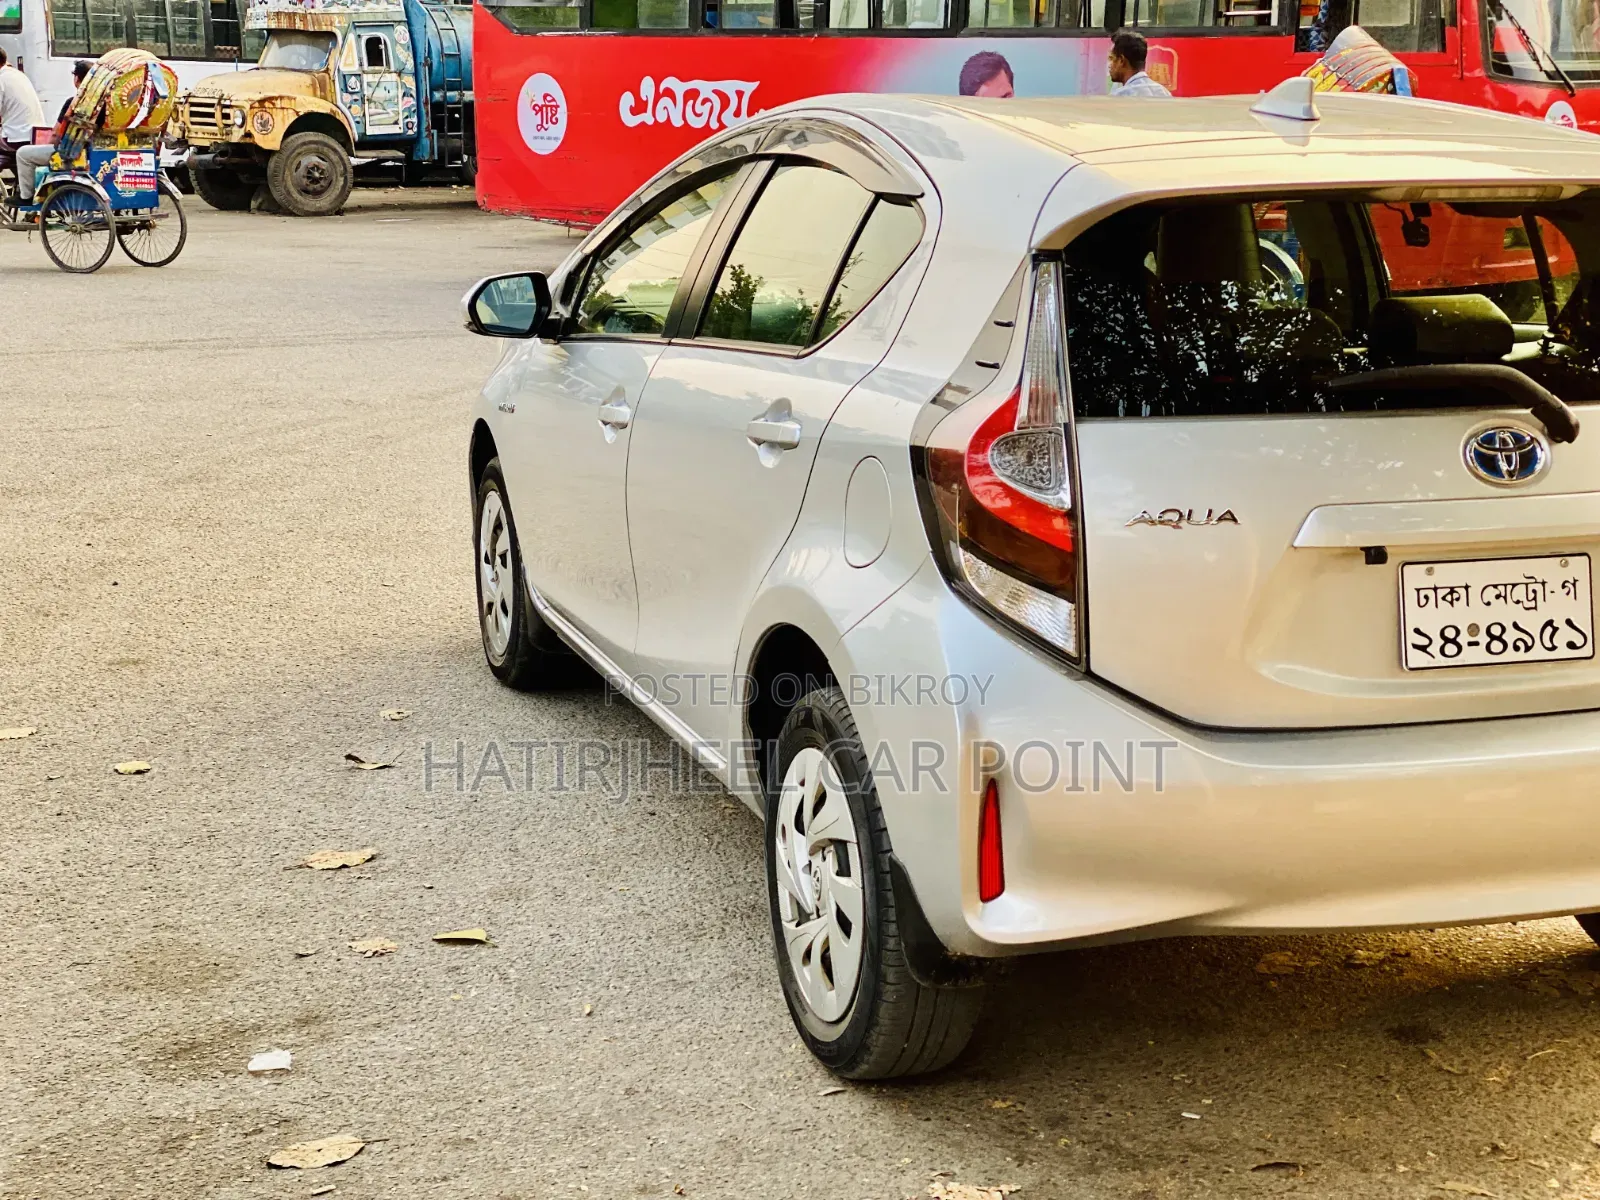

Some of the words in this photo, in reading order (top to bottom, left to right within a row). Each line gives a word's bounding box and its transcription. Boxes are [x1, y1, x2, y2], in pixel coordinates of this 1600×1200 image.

[1124, 507, 1241, 530] AQUA
[1414, 582, 1472, 609] ঢাকা
[1411, 617, 1588, 659] ২৪-৪৯৫১
